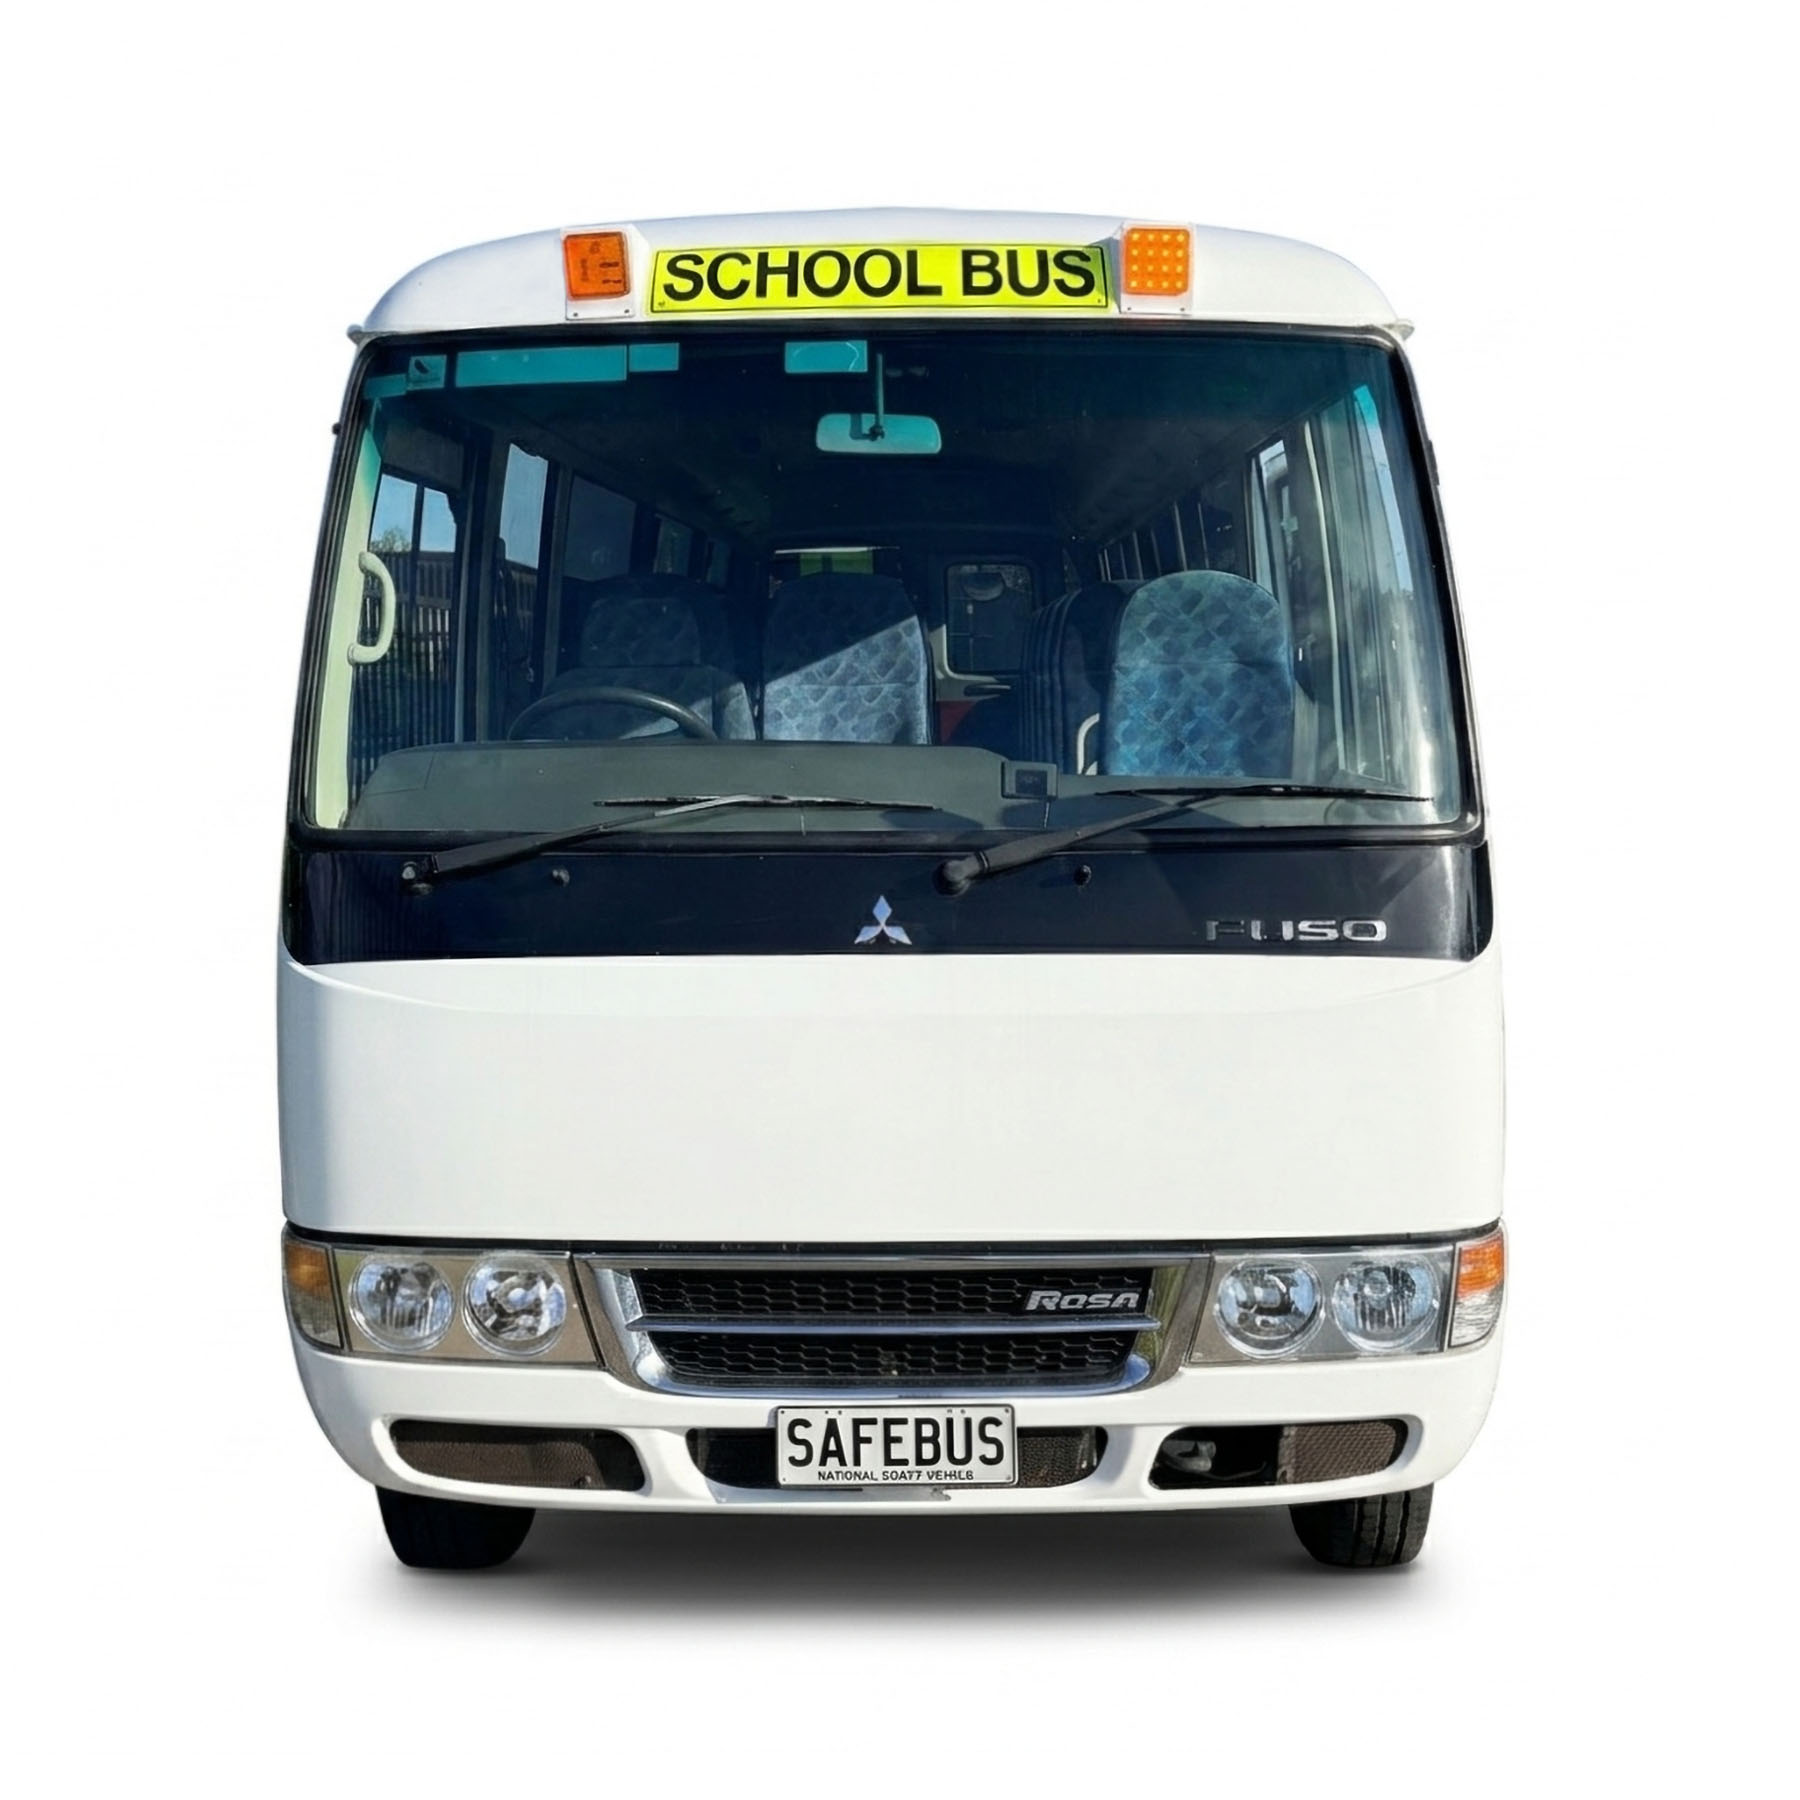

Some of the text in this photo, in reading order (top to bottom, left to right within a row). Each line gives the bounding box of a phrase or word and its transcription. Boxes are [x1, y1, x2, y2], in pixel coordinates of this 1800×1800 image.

[663, 249, 942, 301] SCHOOL
[961, 249, 1095, 297] BUS
[1206, 919, 1387, 941] FUSO
[787, 1417, 1005, 1467] SAFEBUS
[818, 1470, 878, 1481] NATIONAL
